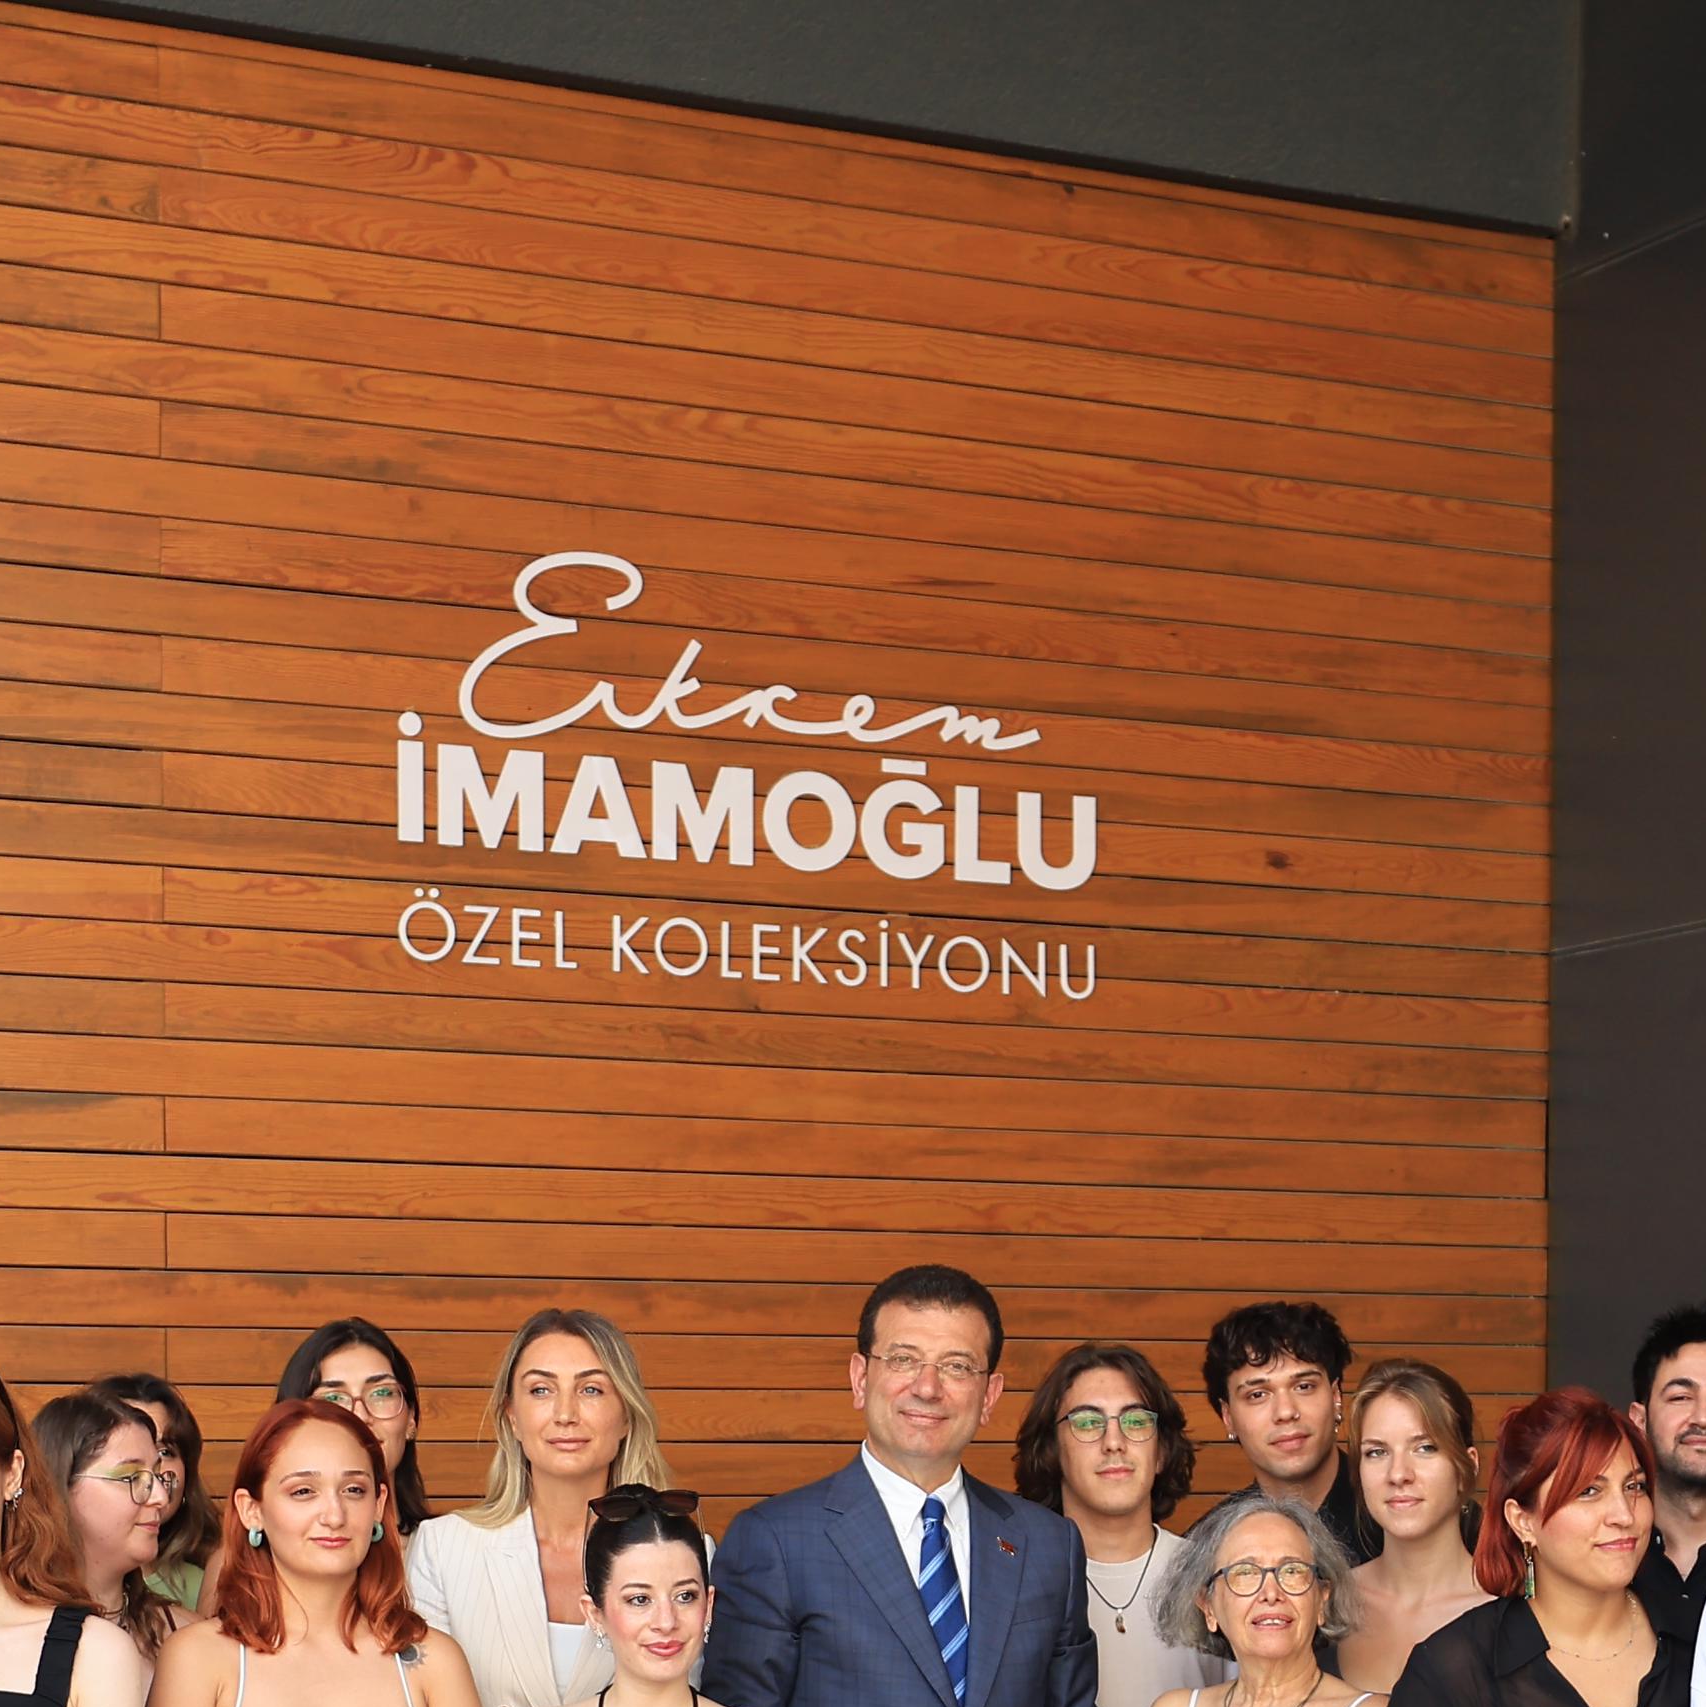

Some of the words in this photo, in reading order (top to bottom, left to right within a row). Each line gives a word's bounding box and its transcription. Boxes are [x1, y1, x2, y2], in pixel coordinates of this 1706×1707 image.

[396, 709, 1098, 892] İMAMOĞLU
[397, 886, 579, 970] ÖZEL
[611, 914, 1097, 1001] KOLEKSİYONU
